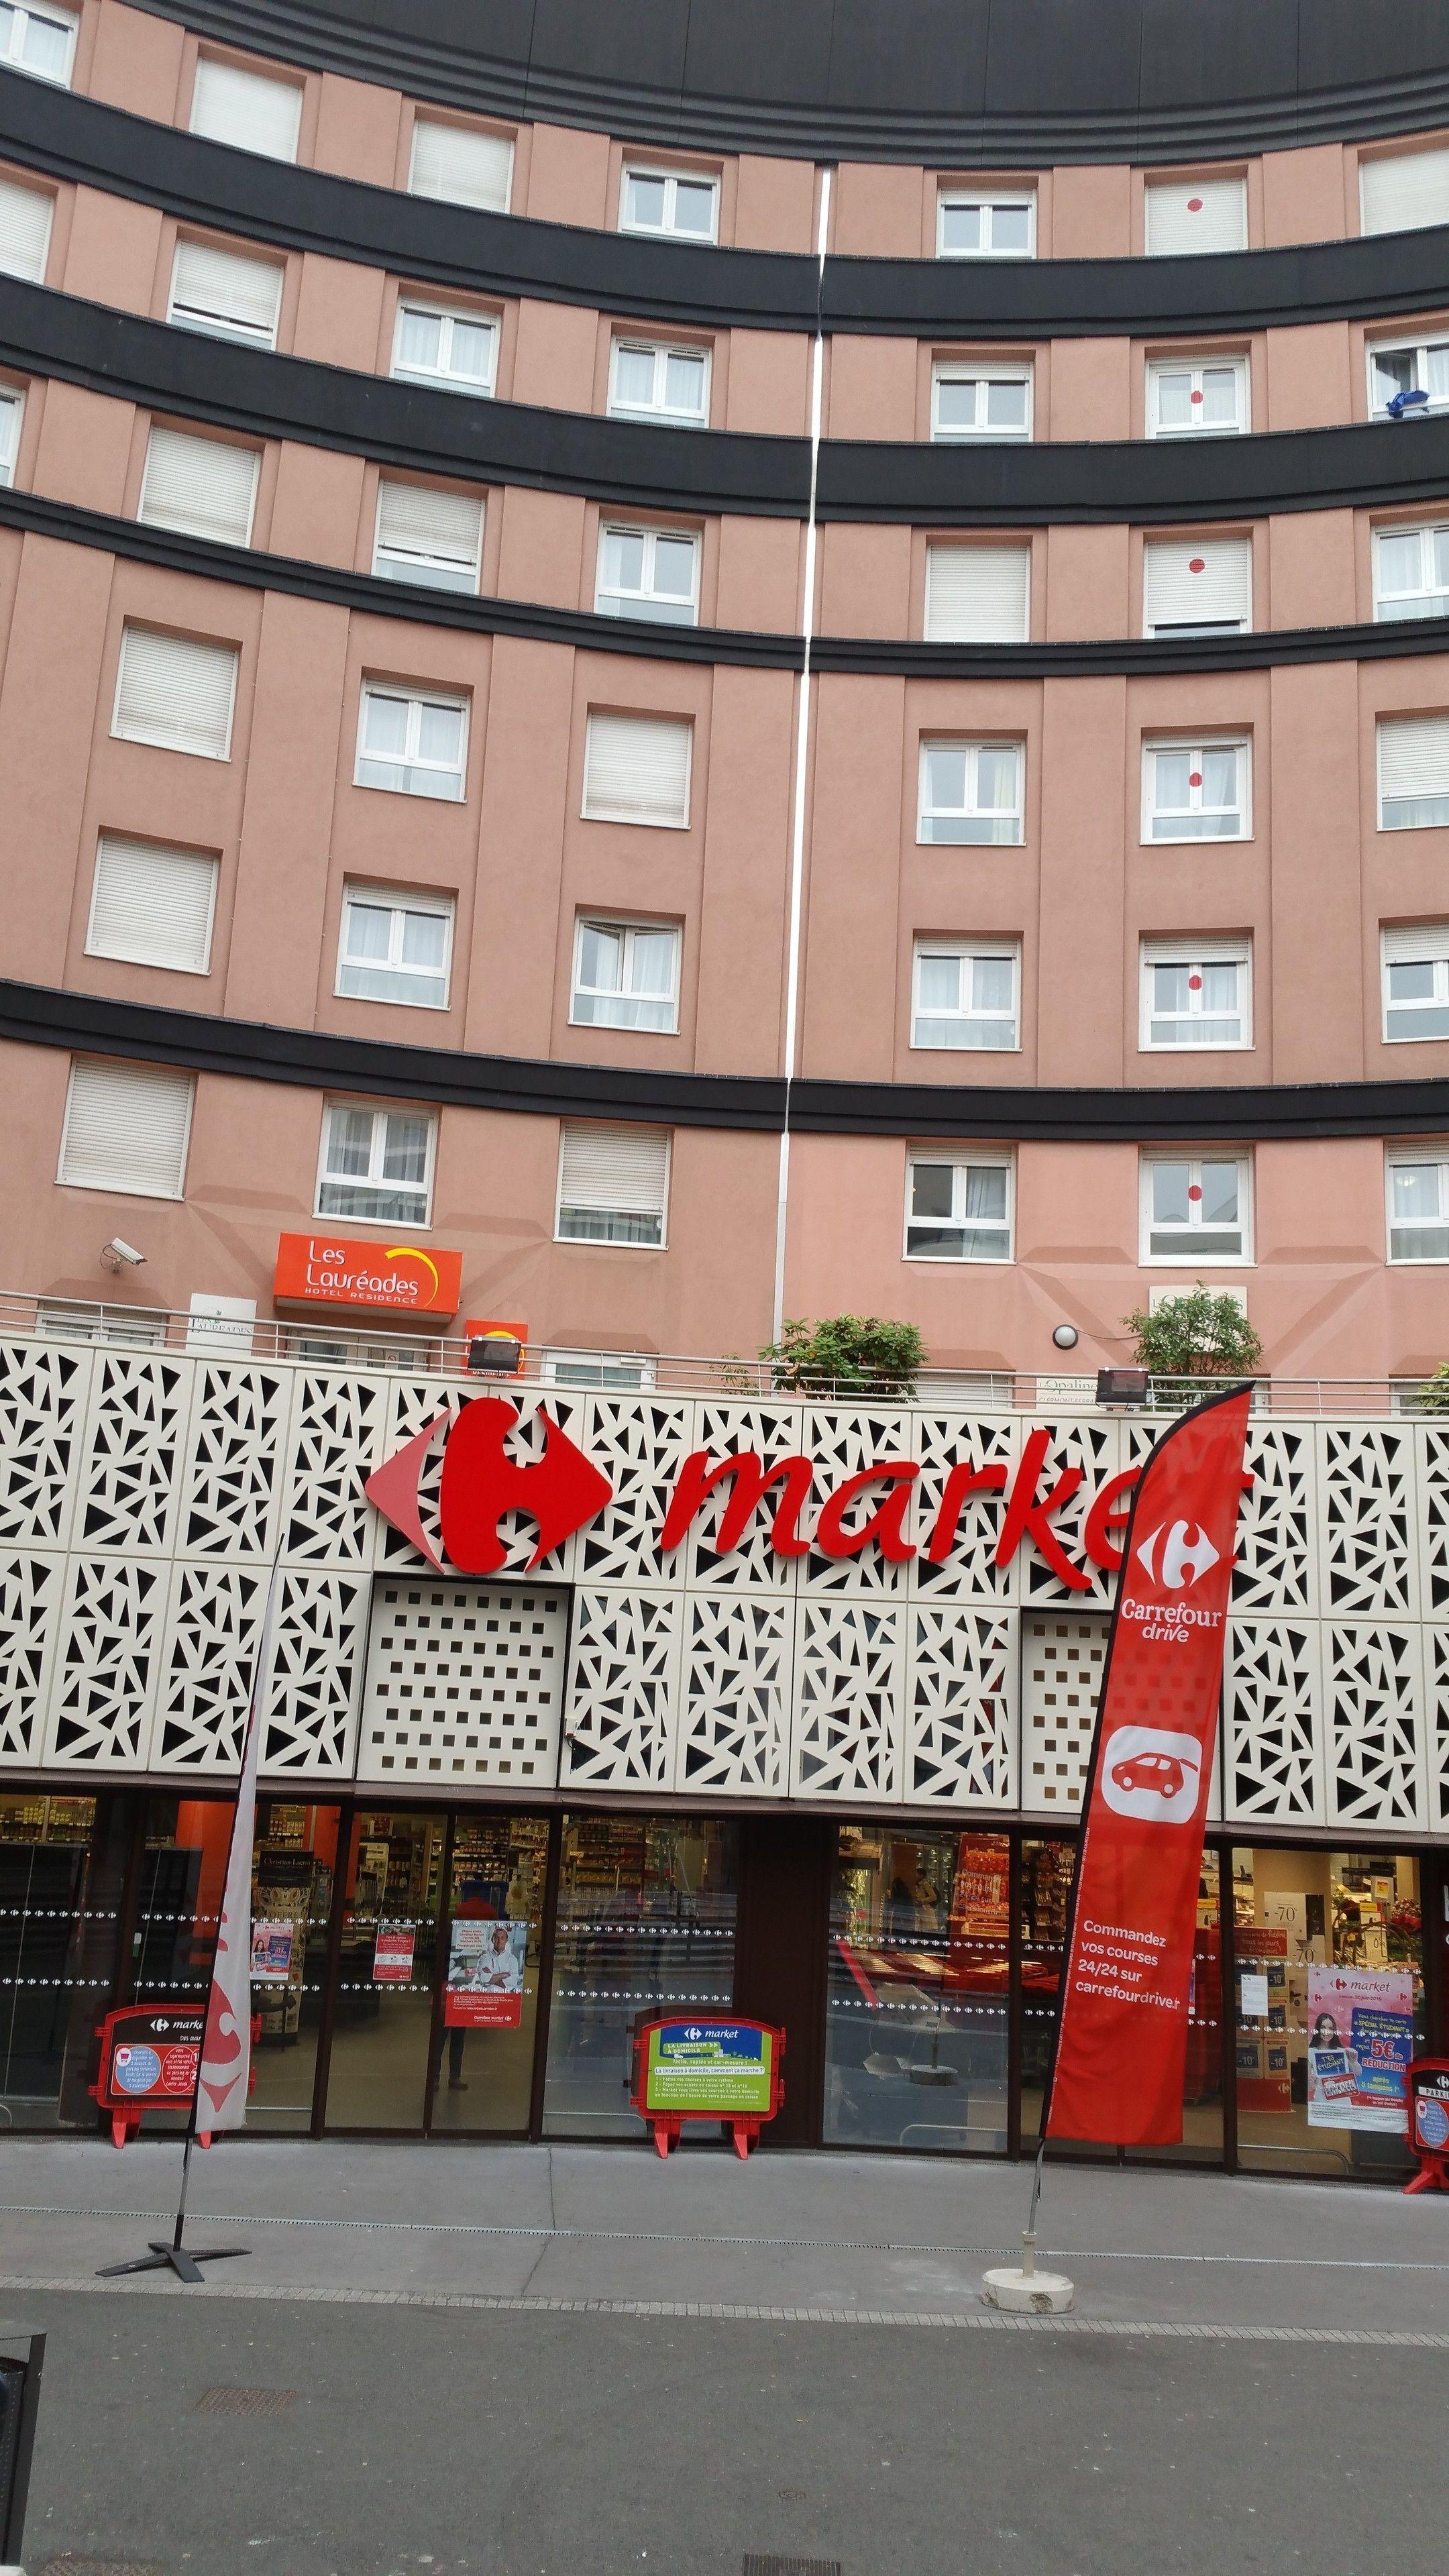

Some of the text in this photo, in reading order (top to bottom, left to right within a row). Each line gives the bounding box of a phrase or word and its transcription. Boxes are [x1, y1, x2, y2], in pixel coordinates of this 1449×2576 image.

[309, 1240, 345, 1265] Les
[307, 1264, 419, 1296] Lauréades
[305, 1287, 417, 1305] HOTEL RESIDENCE
[660, 1430, 1254, 1591] marke
[1122, 1598, 1222, 1627] Carrefour
[1142, 1622, 1189, 1643] drive
[1083, 1920, 1167, 1947] Commandez
[1081, 1941, 1159, 1966] vos courses
[1077, 1959, 1142, 1983] 24/24 sur
[1350, 1981, 1391, 1992] market
[705, 2029, 739, 2039] market
[1371, 2039, 1395, 2059] 5€
[1362, 2056, 1407, 2073] RÉDUCTION
